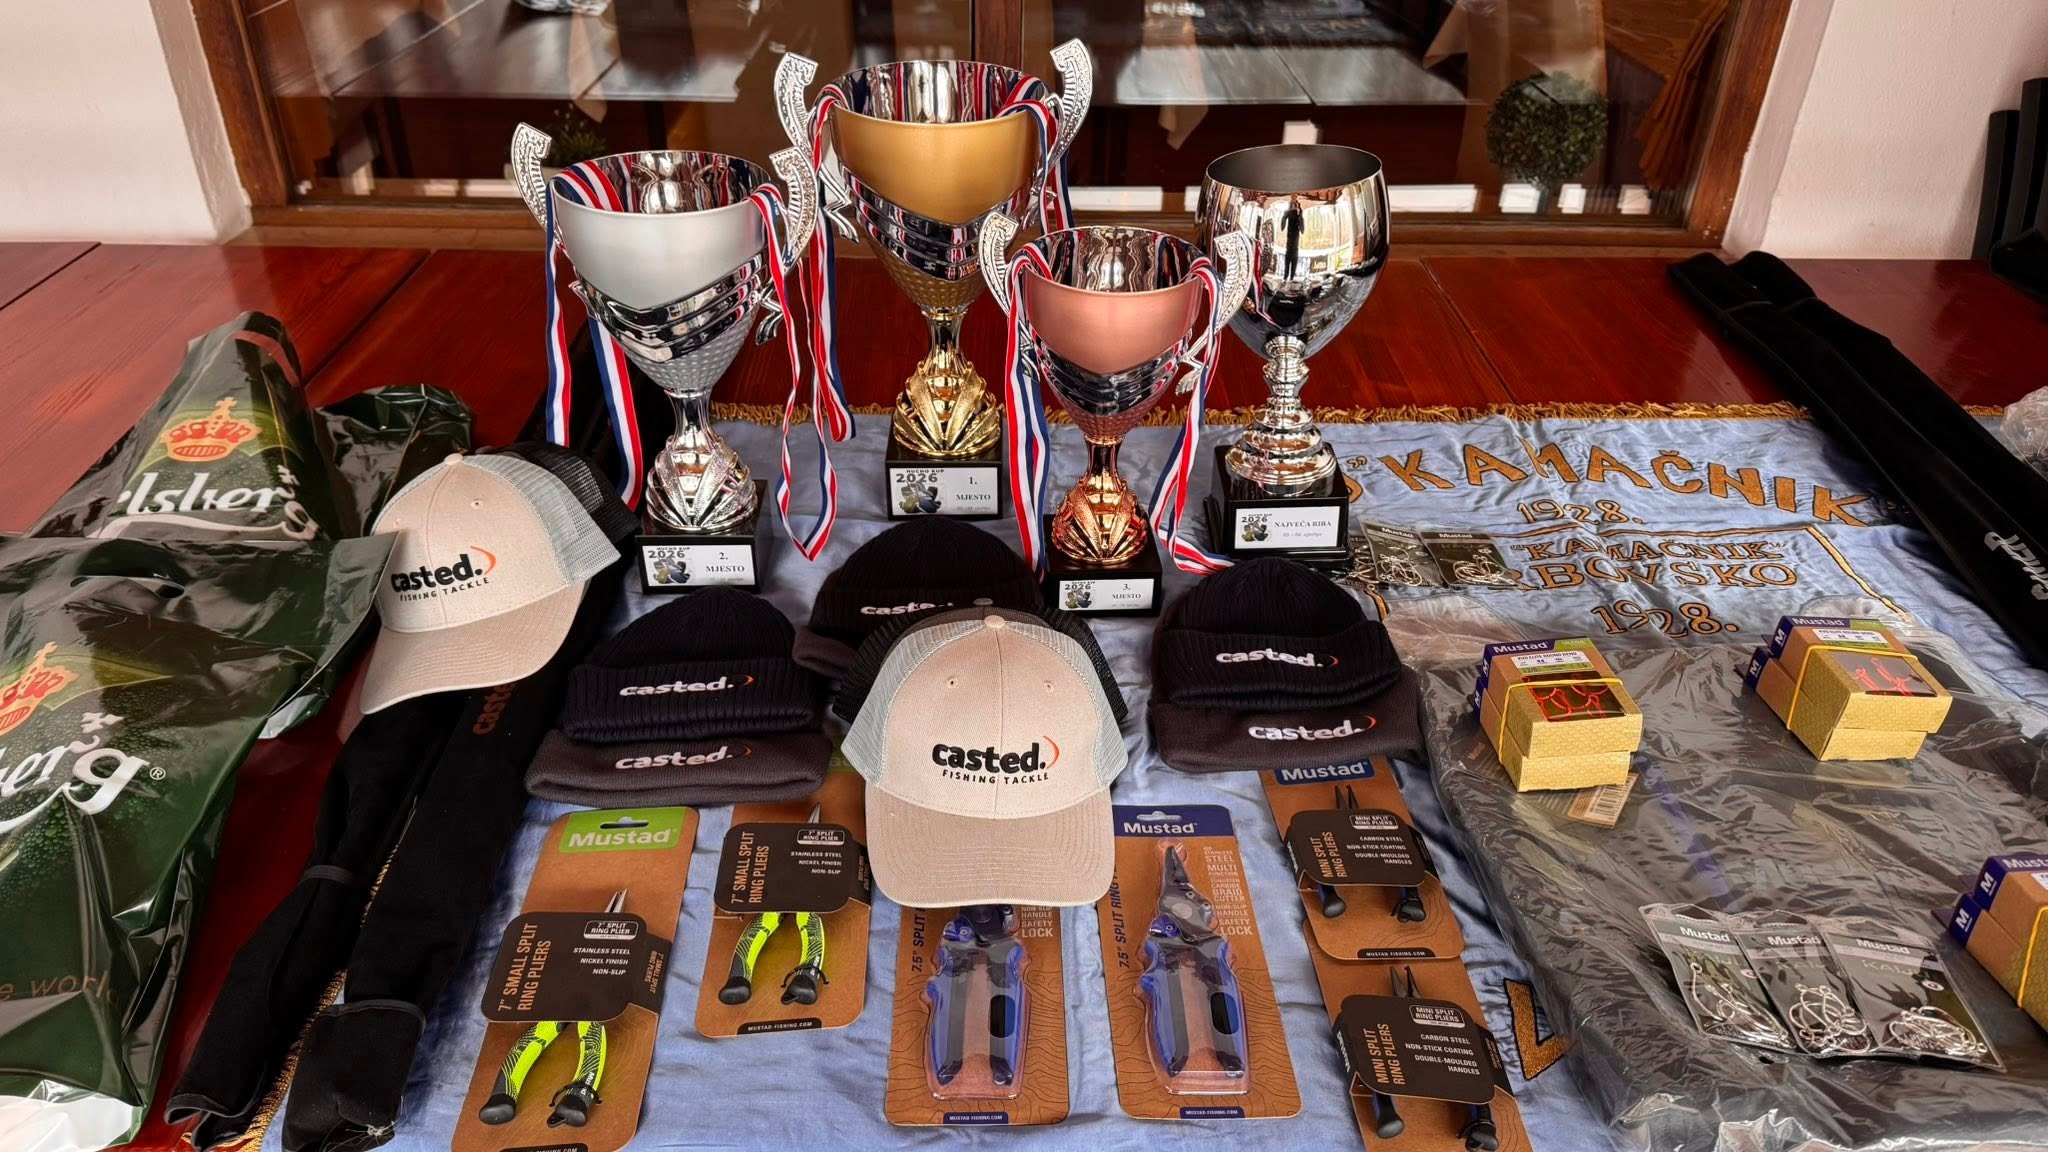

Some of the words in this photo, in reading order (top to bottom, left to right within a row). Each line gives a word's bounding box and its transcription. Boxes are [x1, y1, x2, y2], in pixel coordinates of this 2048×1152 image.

[896, 473, 938, 483] 2026
[969, 476, 978, 484] 1.
[1517, 499, 1644, 525] 1928.
[1274, 520, 1310, 528] NAJVEĆA
[648, 550, 685, 558] 2026
[719, 552, 728, 560] 2.
[400, 591, 437, 602] FISHING
[443, 578, 490, 596] TACKLE
[1792, 617, 1845, 626] Mustad
[1493, 641, 1548, 653] Mustad
[932, 742, 1046, 774] casted.
[942, 770, 996, 784] FISHING
[1004, 772, 1049, 784] TACKLE
[1282, 763, 1365, 781] Mustad
[1124, 822, 1195, 834] Mustad
[568, 828, 672, 848] Mustad
[739, 832, 754, 857] SPLIT
[1322, 831, 1338, 857] PLIERS
[1310, 837, 1327, 859] SPLIT
[752, 846, 769, 878] PLIERS
[1319, 860, 1334, 878] MINI
[1331, 858, 1347, 878] RING
[733, 857, 750, 891] SMALL
[749, 879, 762, 904] RING
[1110, 882, 1122, 908] RING
[913, 915, 925, 947] SPLIT
[1021, 920, 1053, 928] SAFETY
[1022, 928, 1054, 938] LOCK
[1112, 911, 1126, 944] SPLIT
[1221, 926, 1253, 936] LOCK
[516, 923, 538, 953] SPLIT
[1680, 926, 1730, 942] Mustad
[1768, 936, 1822, 945] Mustad
[1856, 938, 1910, 954] Mustad
[912, 950, 922, 972] 7.5"
[1118, 946, 1130, 968] 7.5"
[503, 950, 528, 996] SMALL
[518, 981, 538, 1011] RING
[528, 940, 552, 985] PLIERS
[498, 999, 512, 1012] 7"
[1435, 1008, 1454, 1016] SPLIT
[1435, 1014, 1460, 1022] PLIERS
[1363, 1028, 1382, 1059] SPLIT
[1377, 1023, 1400, 1059] PLIERS
[1420, 1034, 1449, 1042] CARBON
[1405, 1043, 1442, 1052] NON-STICK
[1444, 1047, 1474, 1055] COATING
[1414, 1054, 1478, 1067] DOUBLE-MOULDED
[1373, 1060, 1389, 1084] MINI
[1387, 1059, 1406, 1085] RING
[1448, 1066, 1480, 1075] HANDLES
